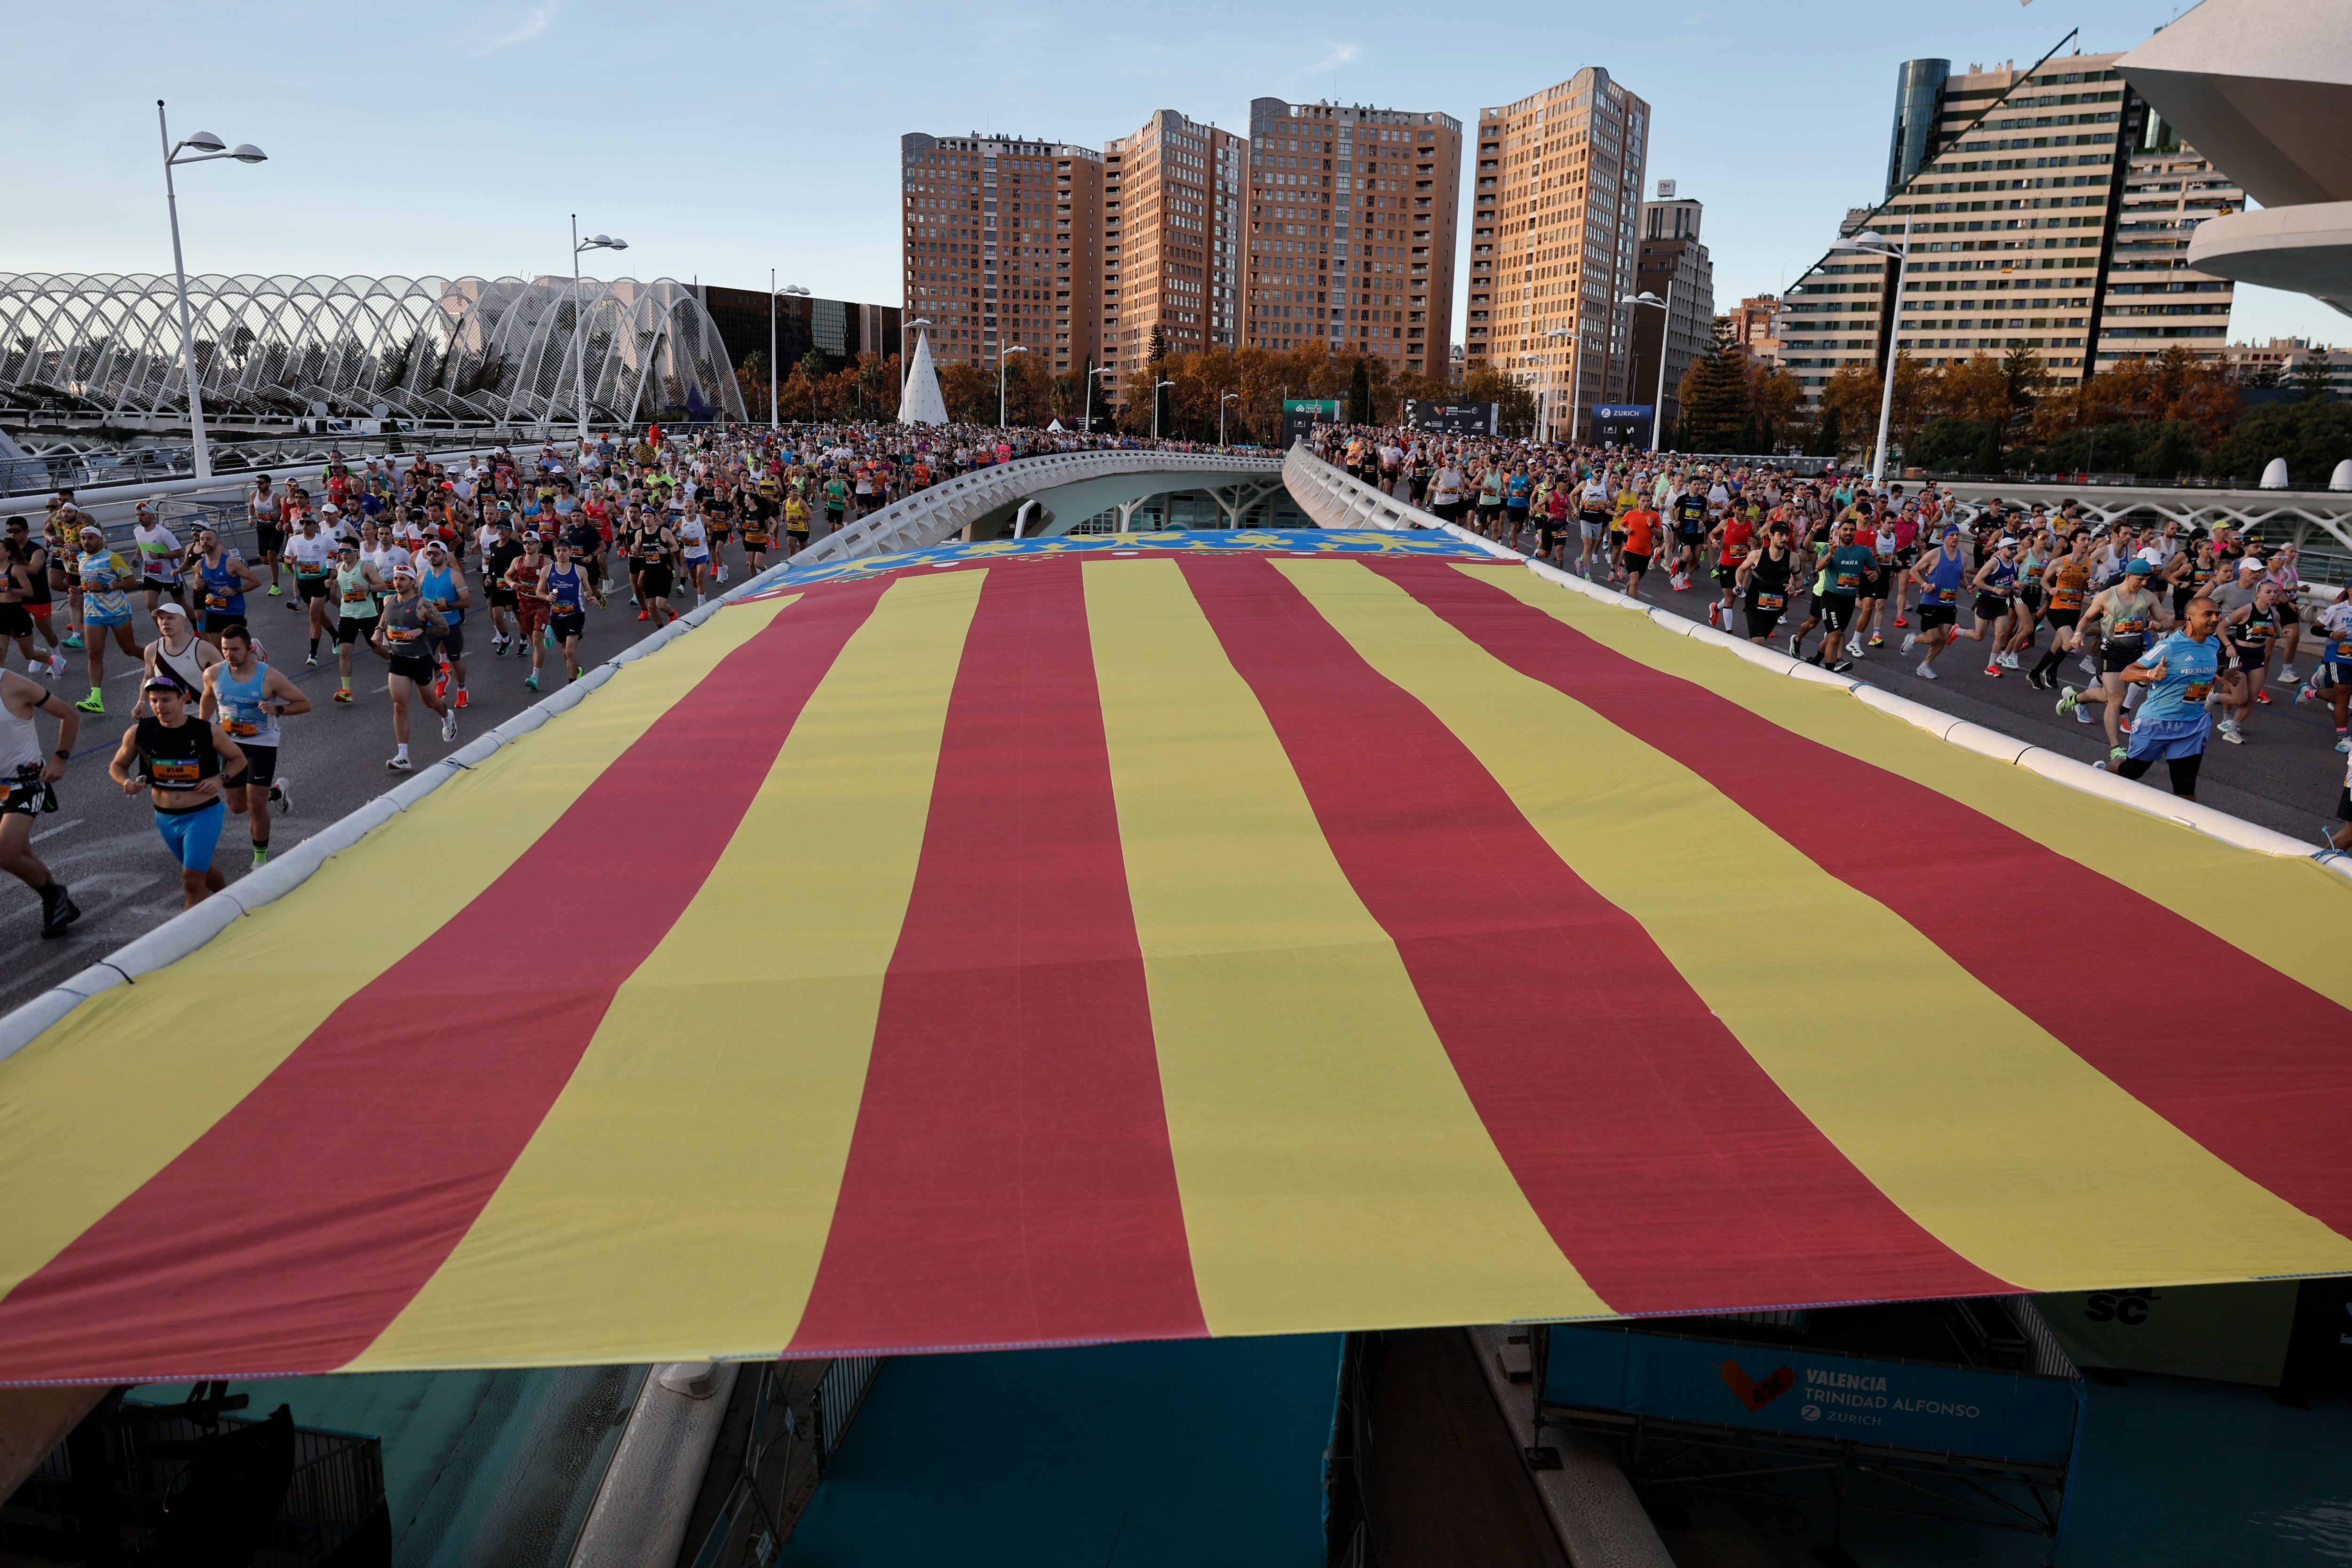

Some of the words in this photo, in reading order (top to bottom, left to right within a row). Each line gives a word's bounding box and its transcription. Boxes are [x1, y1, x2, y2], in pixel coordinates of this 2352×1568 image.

[1830, 611, 1839, 629] BIKILA
[1753, 1374, 1787, 1403] 42K
[1806, 1368, 1887, 1392] VALENCIA
[1804, 1387, 1888, 1409] TRINIDAD
[1892, 1397, 1980, 1418] ALFONSO
[1827, 1411, 1882, 1426] ZURICH
